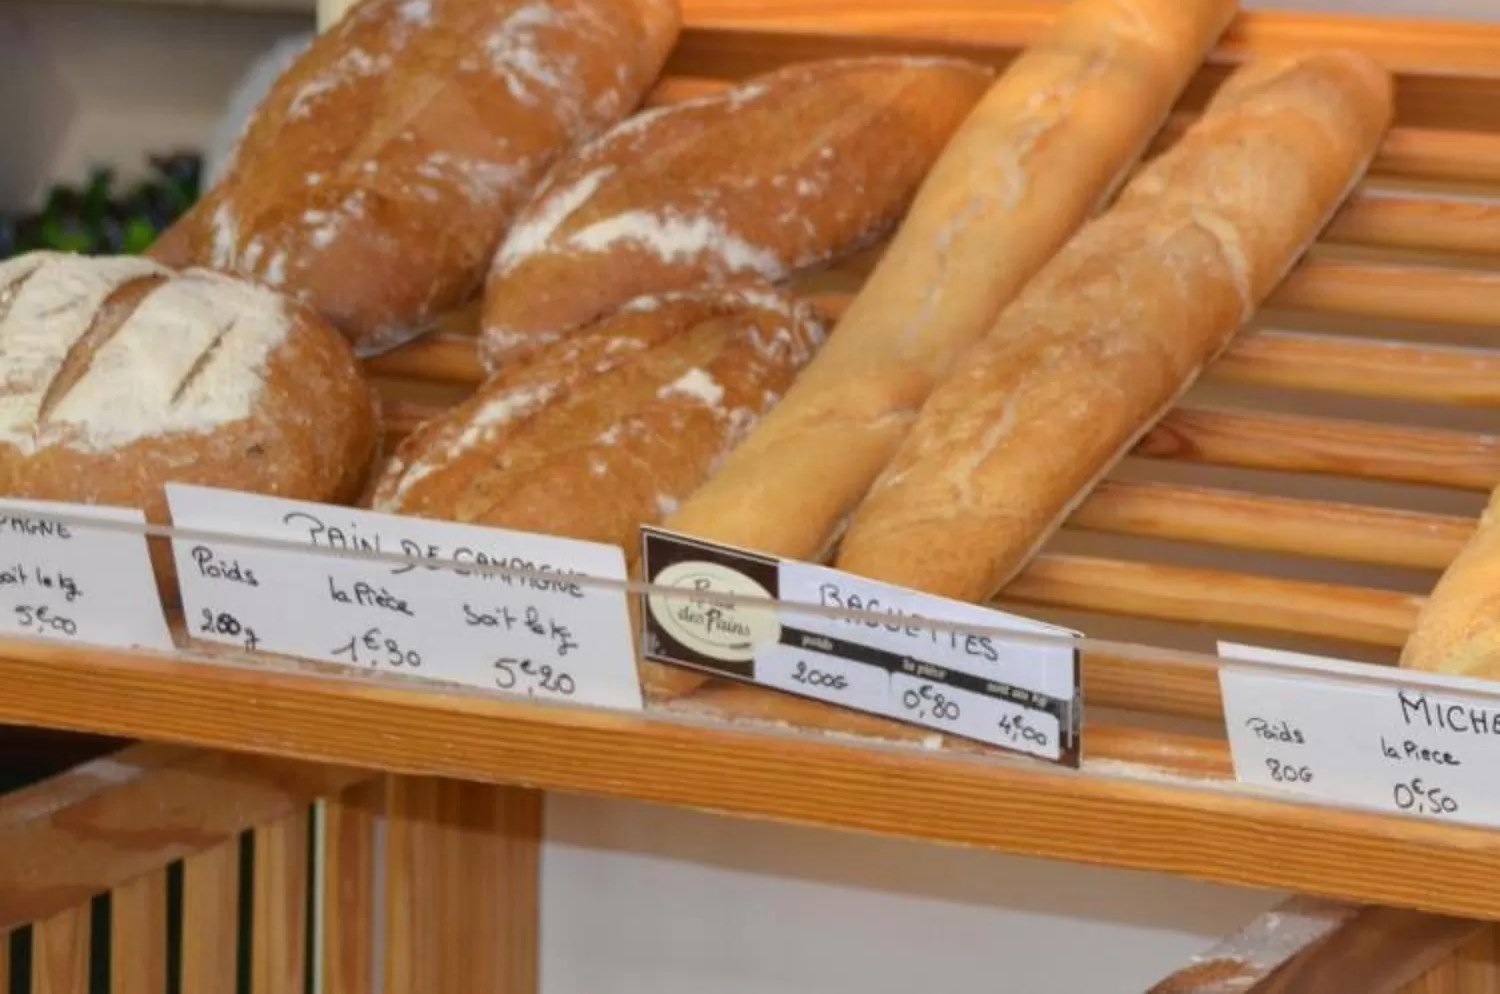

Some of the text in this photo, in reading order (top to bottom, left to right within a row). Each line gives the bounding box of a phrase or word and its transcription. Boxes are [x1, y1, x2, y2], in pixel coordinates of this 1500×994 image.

[0, 515, 72, 539] AGNE
[0, 562, 28, 585] oit
[191, 545, 260, 588] Poids
[328, 574, 353, 604] la
[1244, 716, 1306, 745] Poids
[1380, 736, 1401, 760] la
